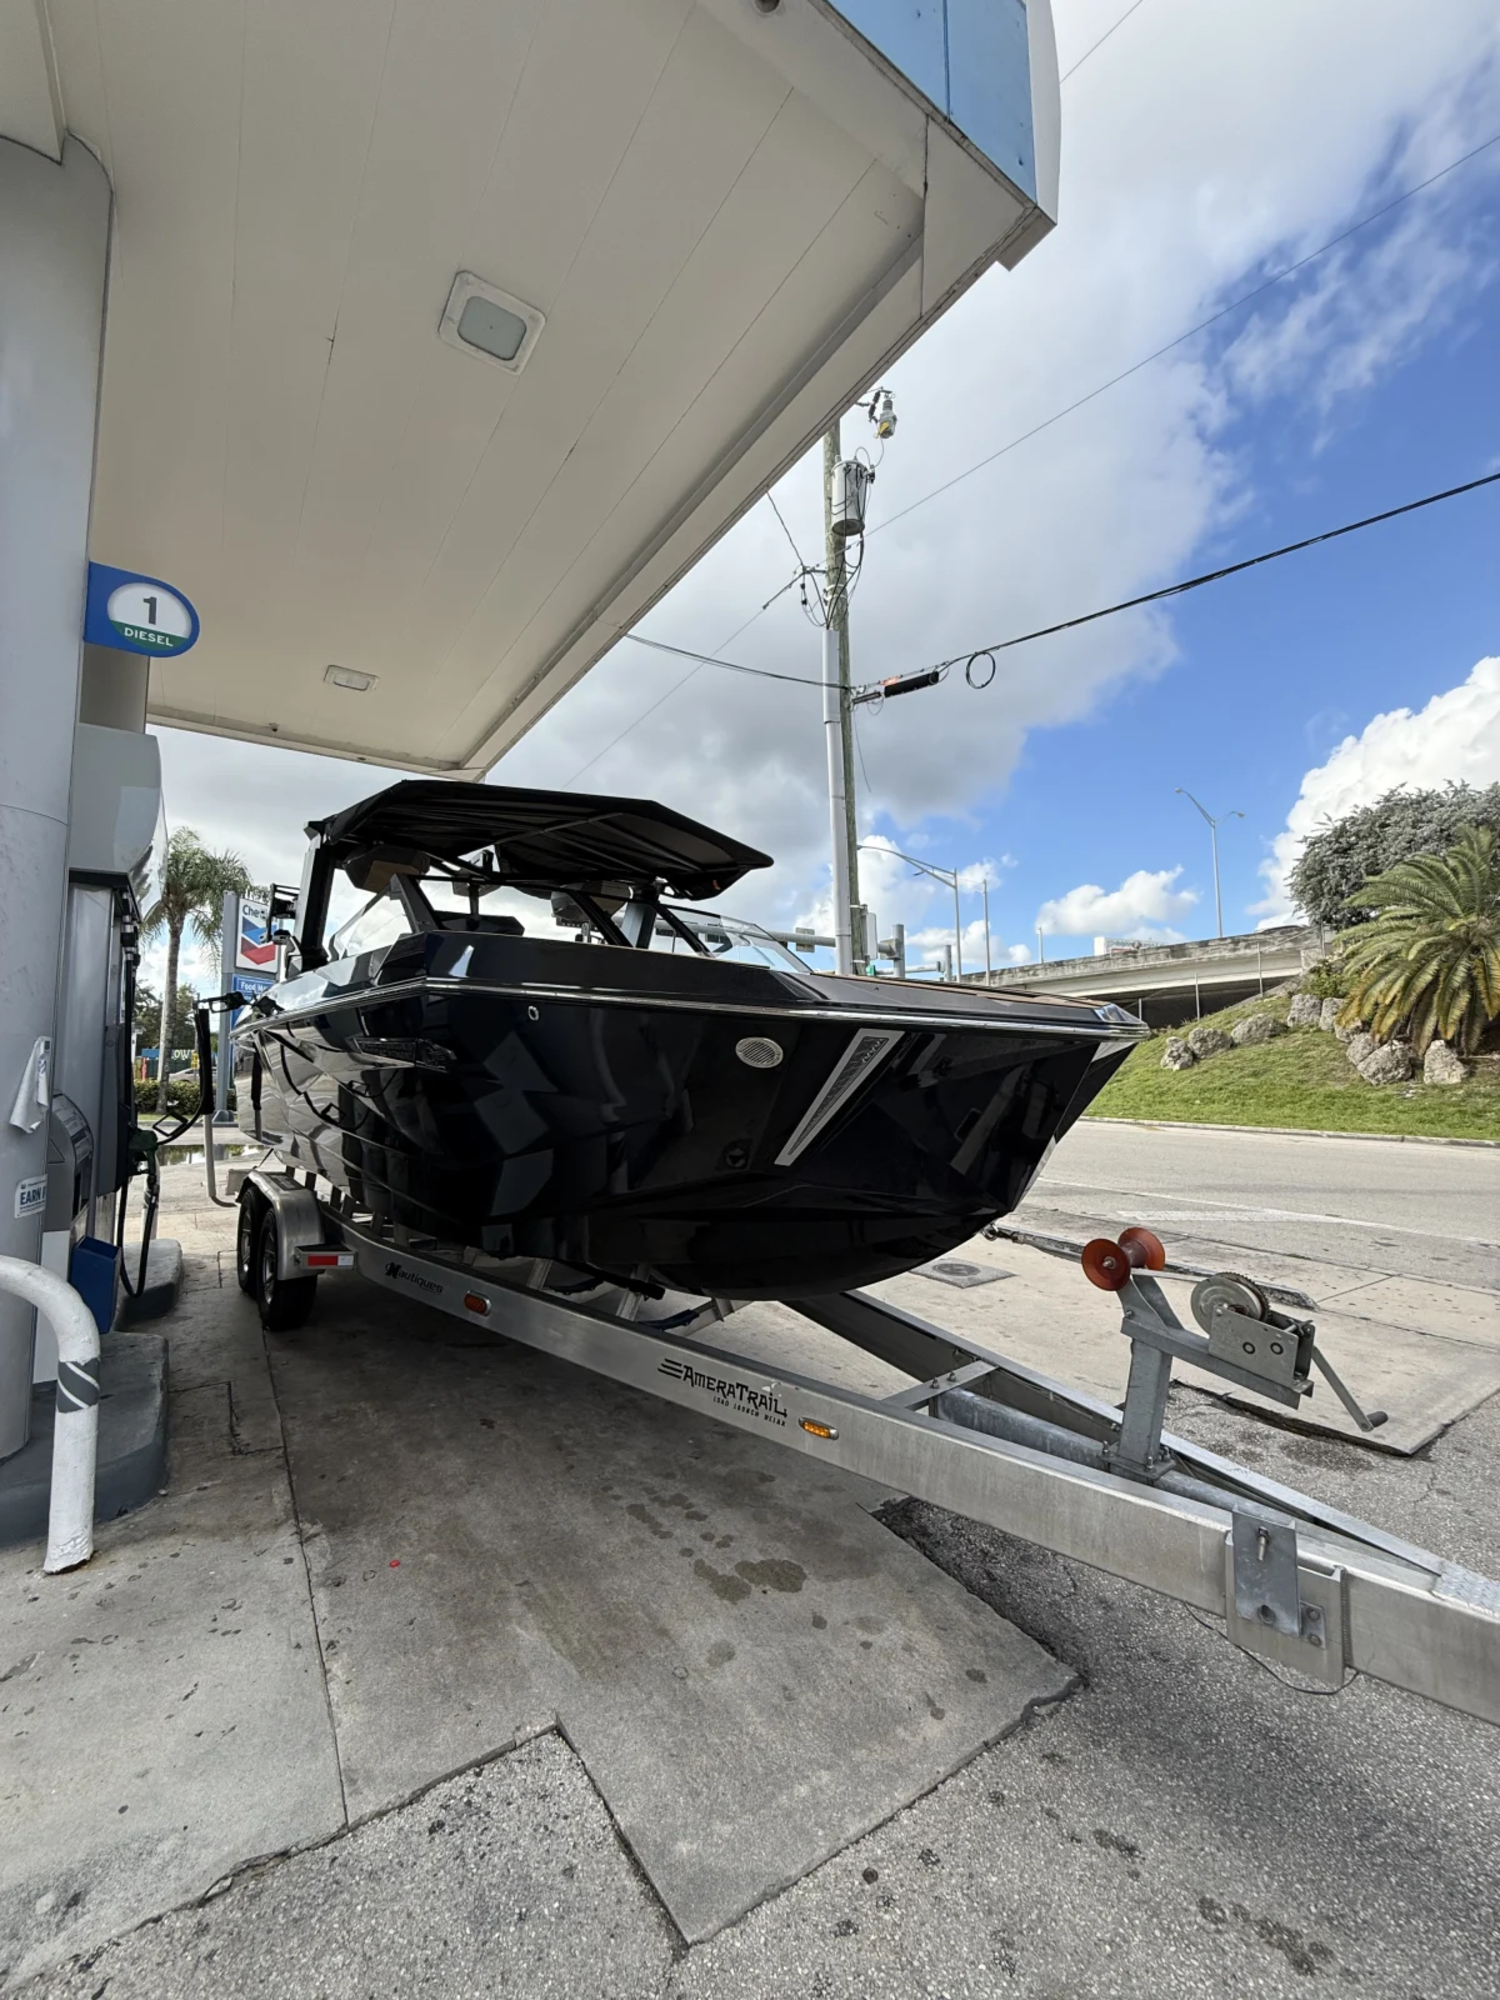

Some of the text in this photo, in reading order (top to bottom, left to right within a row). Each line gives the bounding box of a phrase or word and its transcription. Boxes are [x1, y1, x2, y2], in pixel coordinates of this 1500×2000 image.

[143, 596, 157, 625] 1
[124, 627, 174, 647] DIESEL
[242, 904, 261, 918] Che
[241, 981, 256, 991] Food
[20, 1187, 42, 1206] EARN
[385, 1262, 444, 1293] Nautiques
